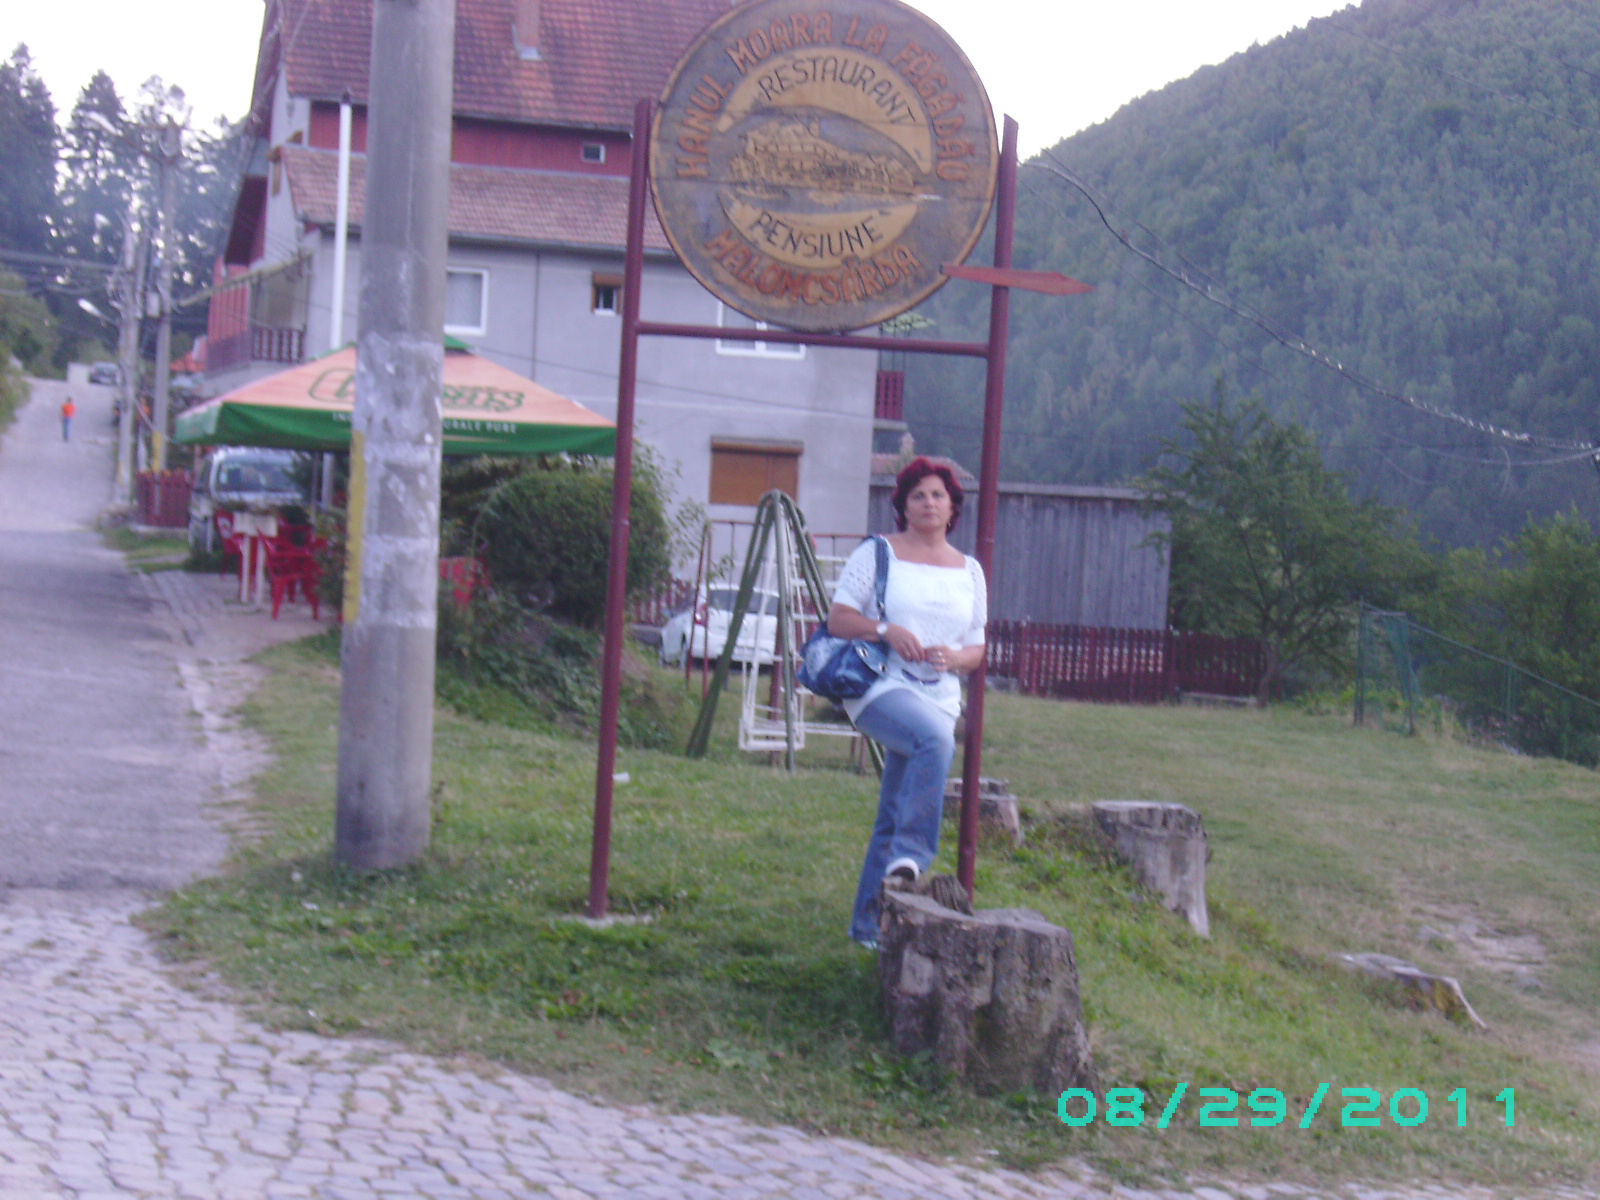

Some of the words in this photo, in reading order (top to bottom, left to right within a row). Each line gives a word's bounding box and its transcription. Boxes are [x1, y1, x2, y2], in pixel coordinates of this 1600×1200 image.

[677, 74, 734, 179] HANUL
[725, 11, 833, 75] MOARA
[844, 15, 889, 56] LA
[757, 56, 917, 124] RESTAURANT
[750, 210, 883, 259] PENSIUNE
